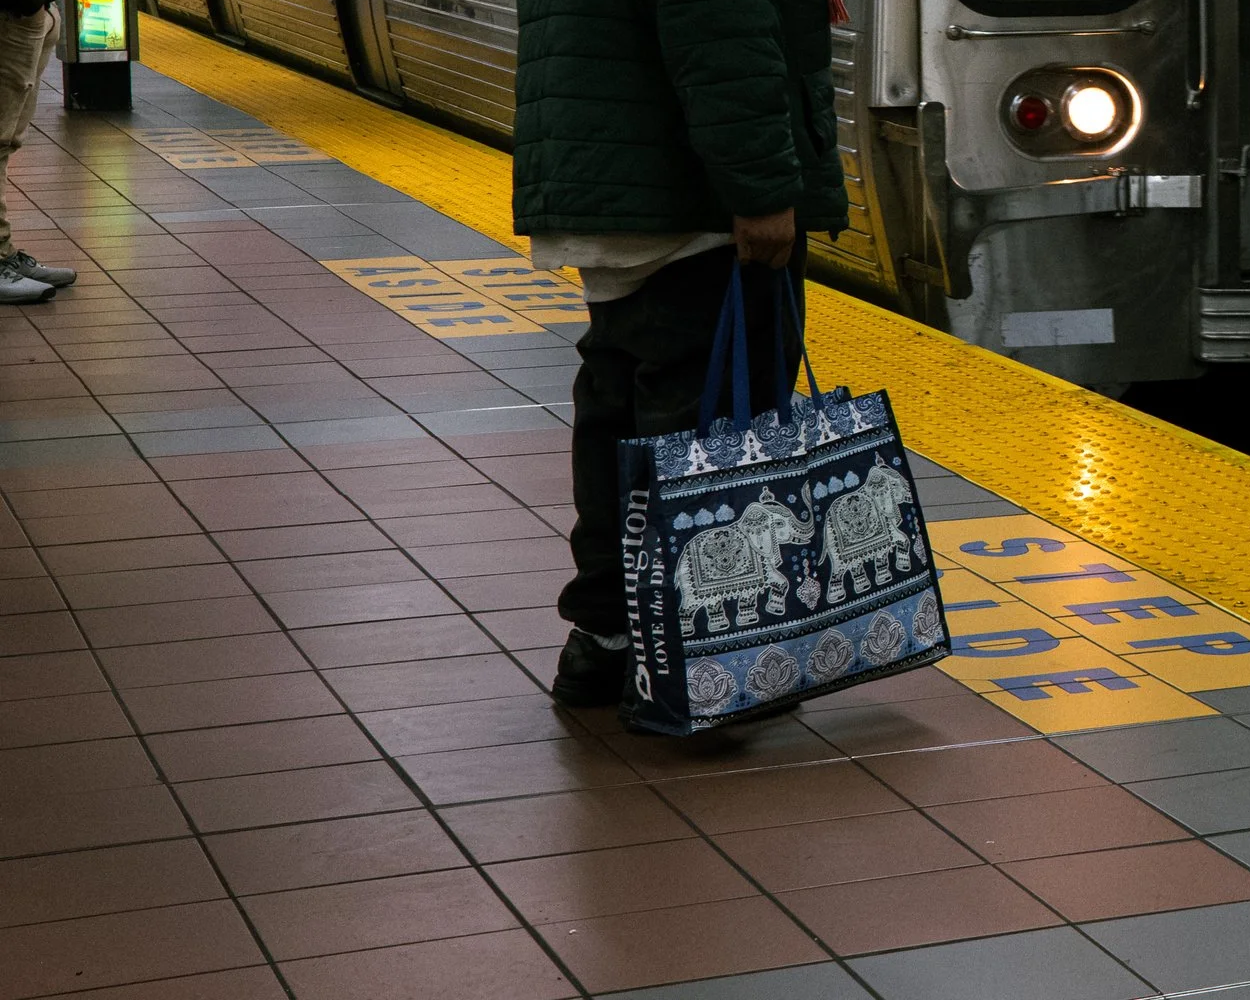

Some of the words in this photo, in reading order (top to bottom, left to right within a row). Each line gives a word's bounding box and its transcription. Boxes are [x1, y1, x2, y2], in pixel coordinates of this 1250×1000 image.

[345, 266, 513, 328] ASIDE
[650, 589, 665, 617] the
[651, 622, 670, 676] LOVE
